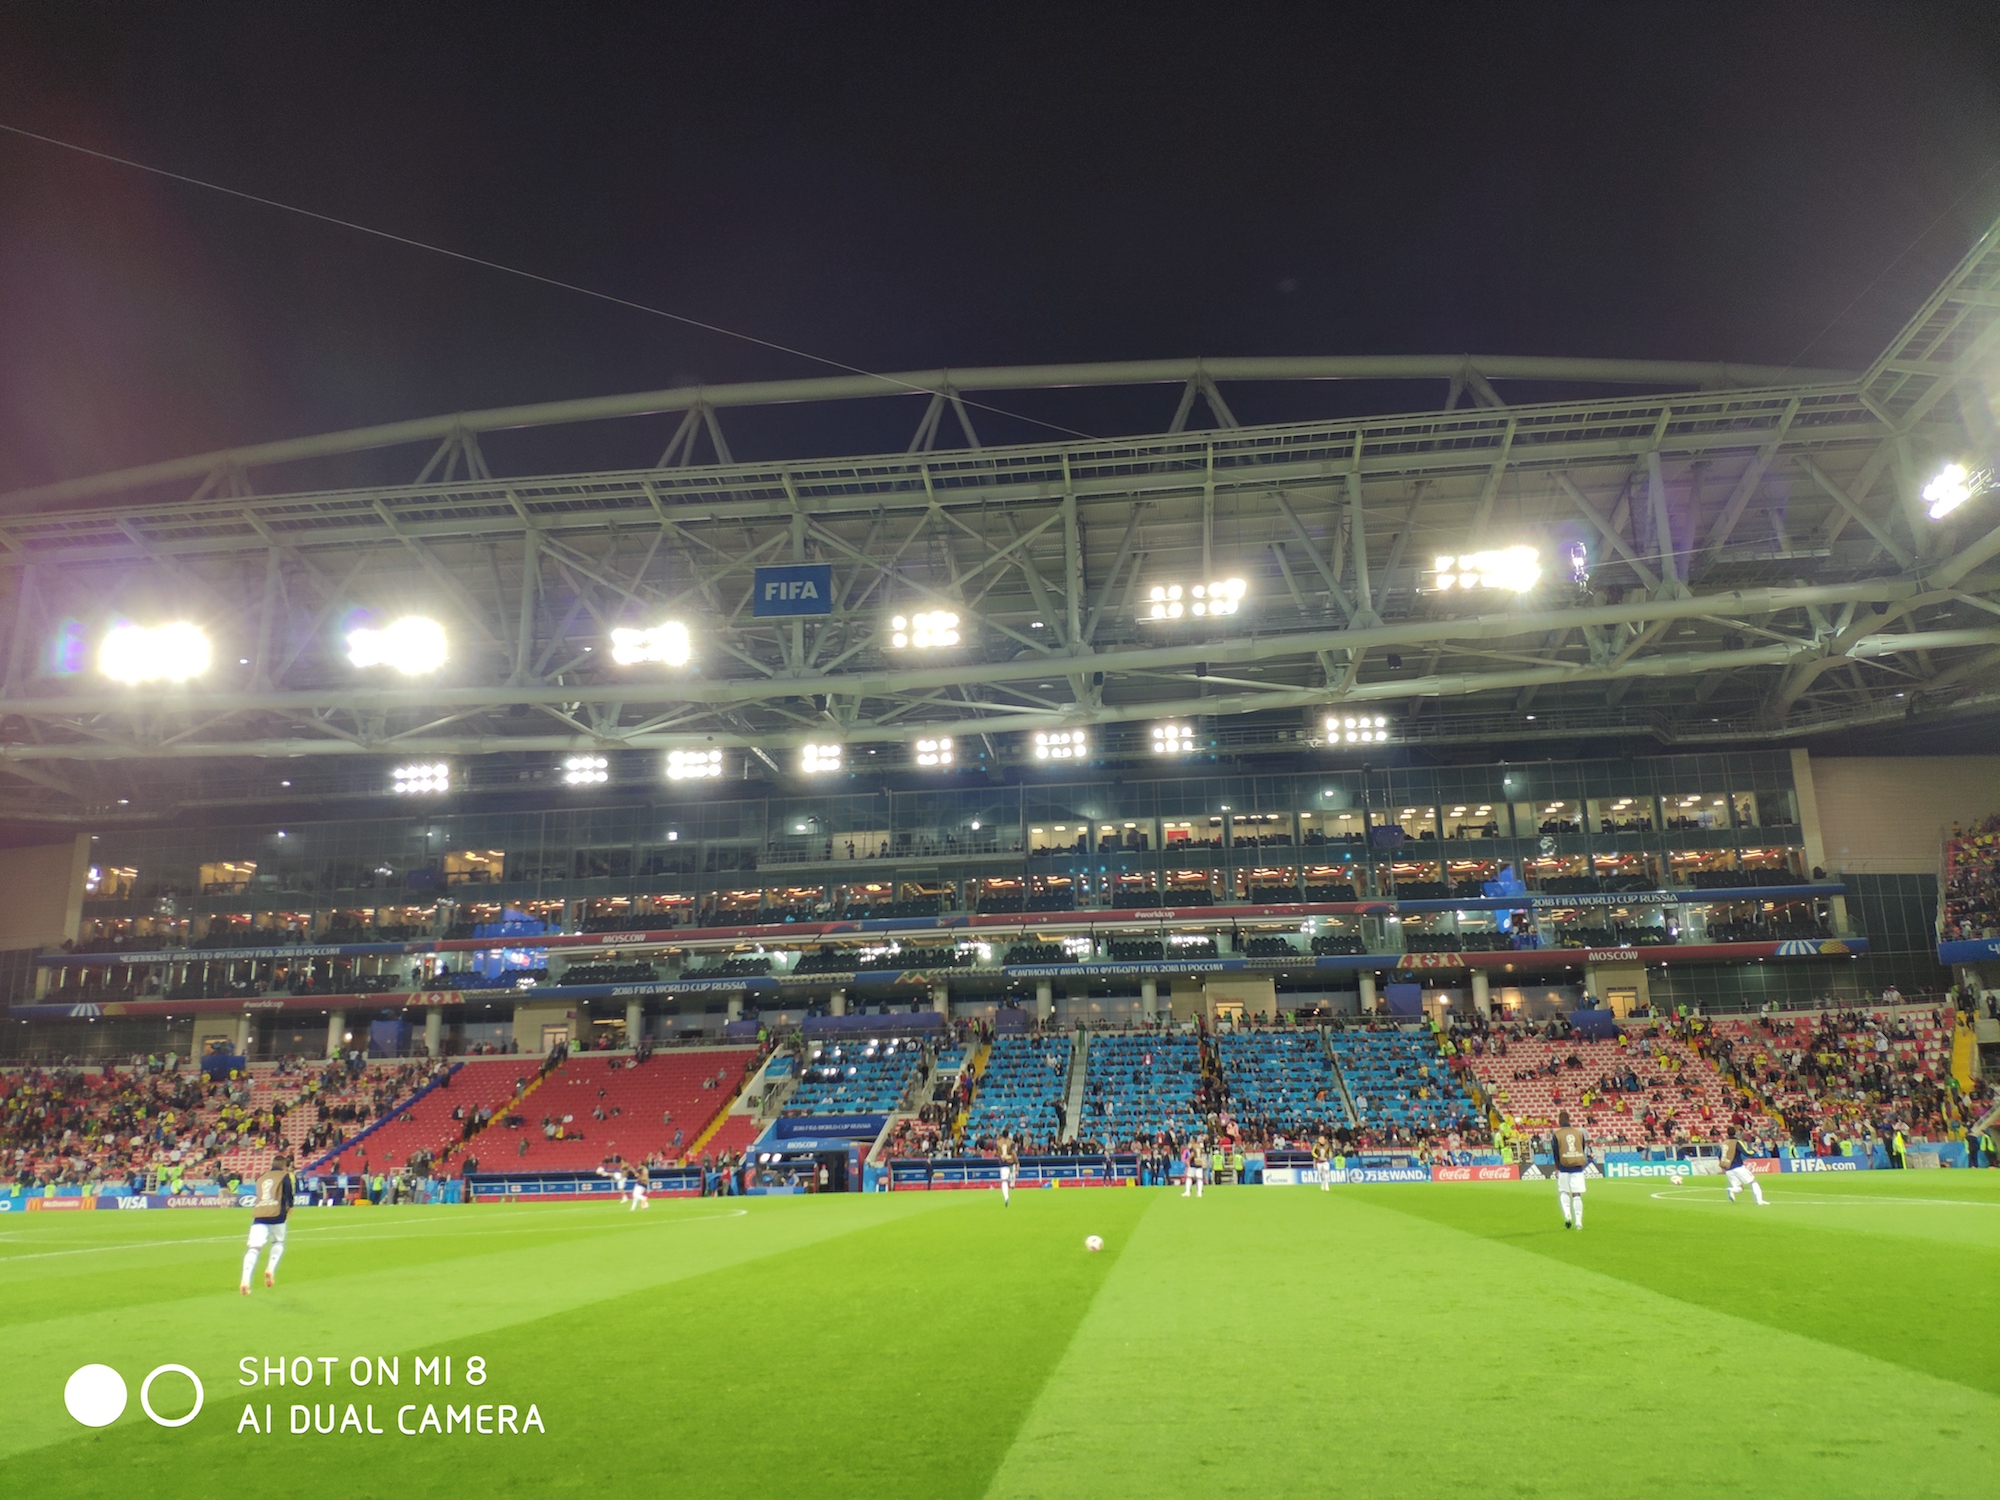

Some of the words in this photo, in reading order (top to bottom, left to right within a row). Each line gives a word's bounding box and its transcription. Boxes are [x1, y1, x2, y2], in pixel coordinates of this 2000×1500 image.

[765, 581, 819, 601] FIFA
[1532, 898, 1555, 908] 2018
[1556, 897, 1578, 907] FIFA
[1579, 895, 1616, 905] WORLD
[1616, 894, 1638, 904] CUP
[1640, 892, 1678, 902] RUSSIA
[1134, 910, 1175, 919] #worldcup
[602, 933, 646, 944] MOSCOW
[1588, 950, 1638, 962] MOSCOW
[1008, 967, 1058, 977] ЧЕМПИОНАТ
[1060, 967, 1085, 976] МИРА
[1086, 966, 1099, 975] ПО
[1140, 965, 1159, 974] FIFA
[1160, 964, 1179, 973] 2018
[1188, 963, 1223, 972] РОССИИ
[611, 986, 634, 996] 2018
[634, 985, 654, 995] FIFA
[655, 983, 690, 994] WORLD
[690, 982, 711, 992] CUP
[711, 981, 747, 991] RUSSIA
[1607, 1162, 1690, 1178] Hisense
[1747, 1161, 1771, 1173] Bud
[1790, 1158, 1857, 1173] FIFA.com
[1364, 1170, 1390, 1182] 万达
[116, 1196, 148, 1210] VISA
[167, 1196, 198, 1208] QATAR
